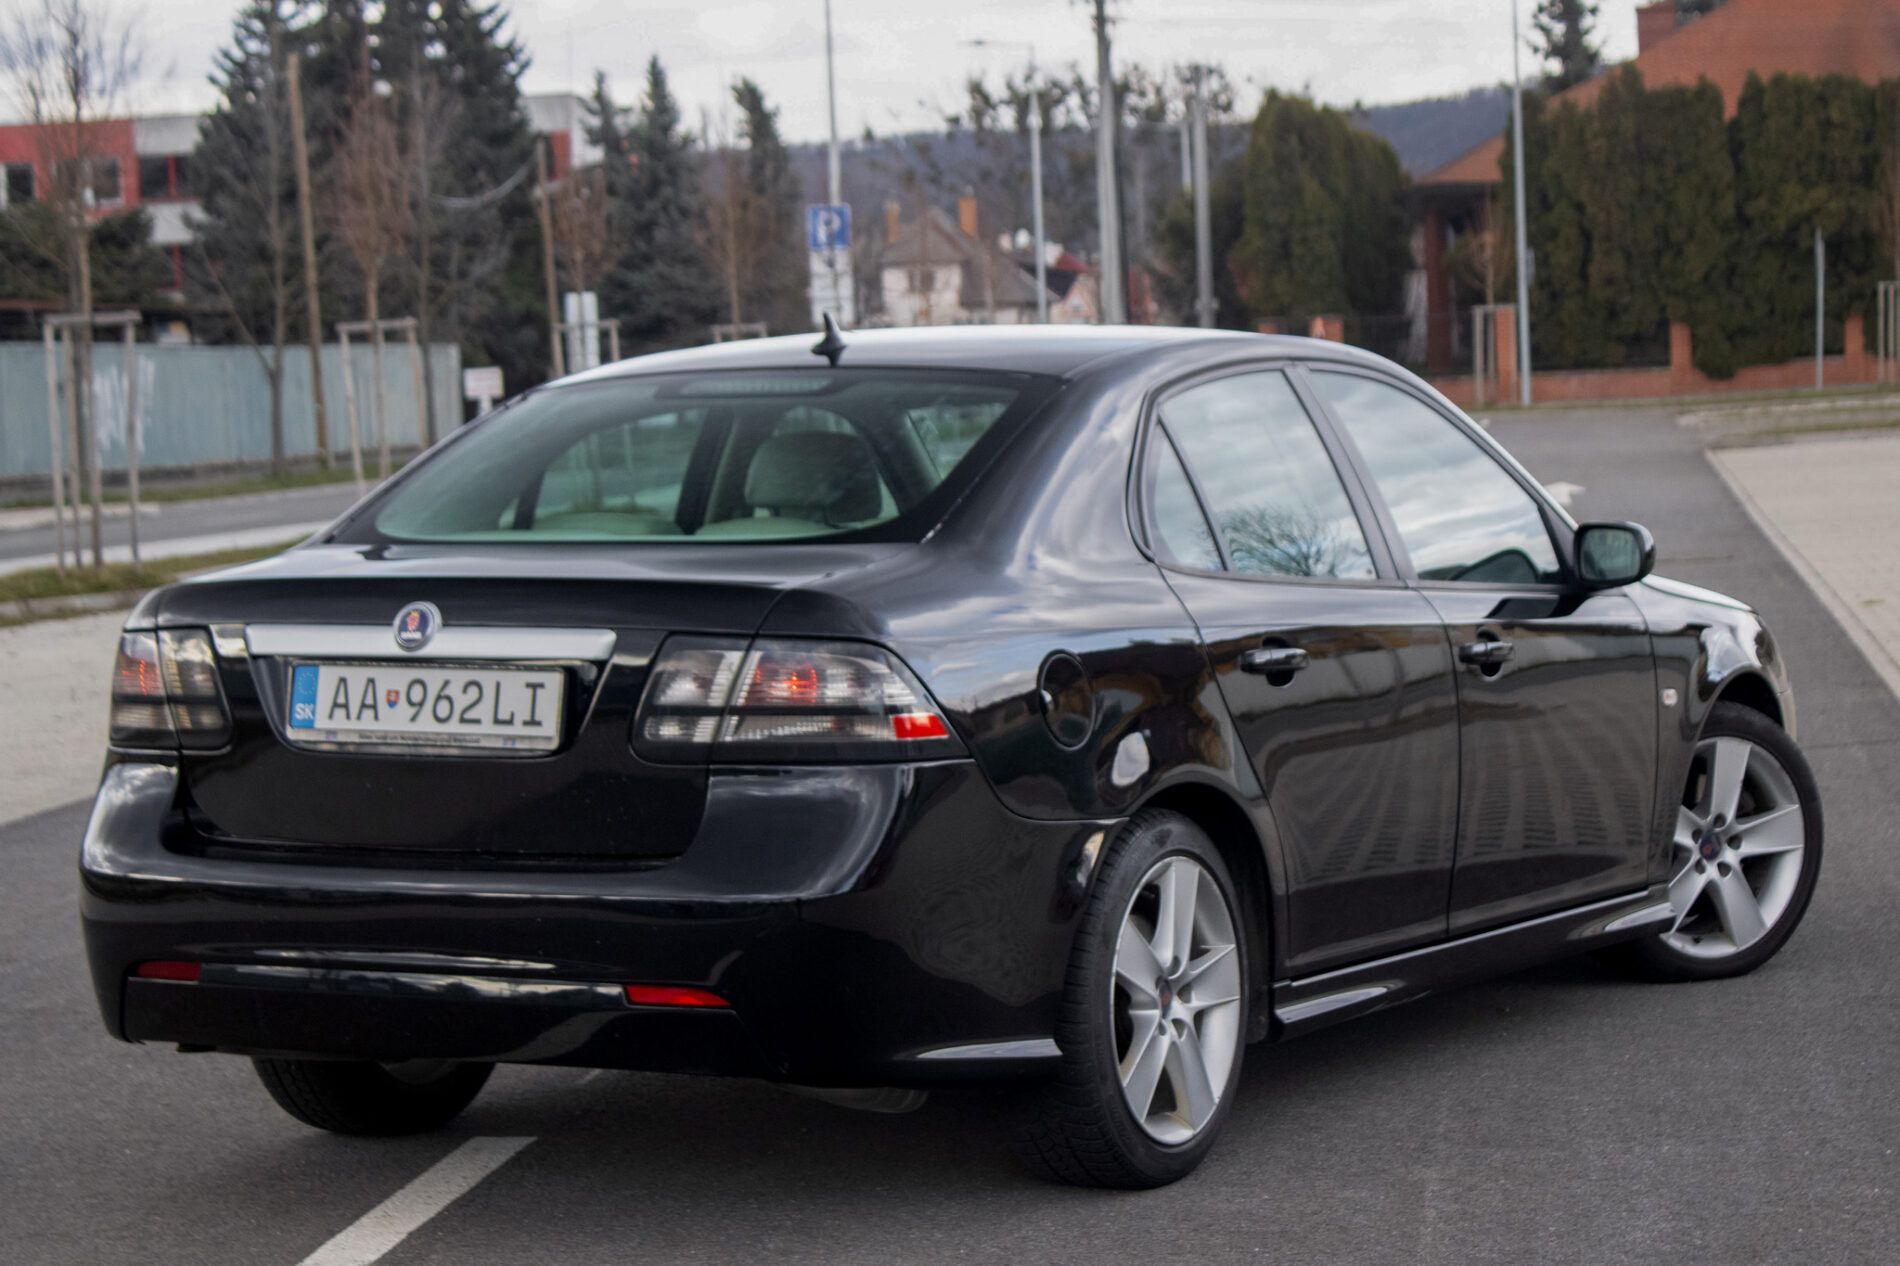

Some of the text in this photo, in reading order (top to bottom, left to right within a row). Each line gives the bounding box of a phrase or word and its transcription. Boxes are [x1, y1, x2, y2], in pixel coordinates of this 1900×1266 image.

[818, 209, 842, 243] P
[295, 703, 315, 720] SK
[328, 676, 546, 726] AA 962LI
